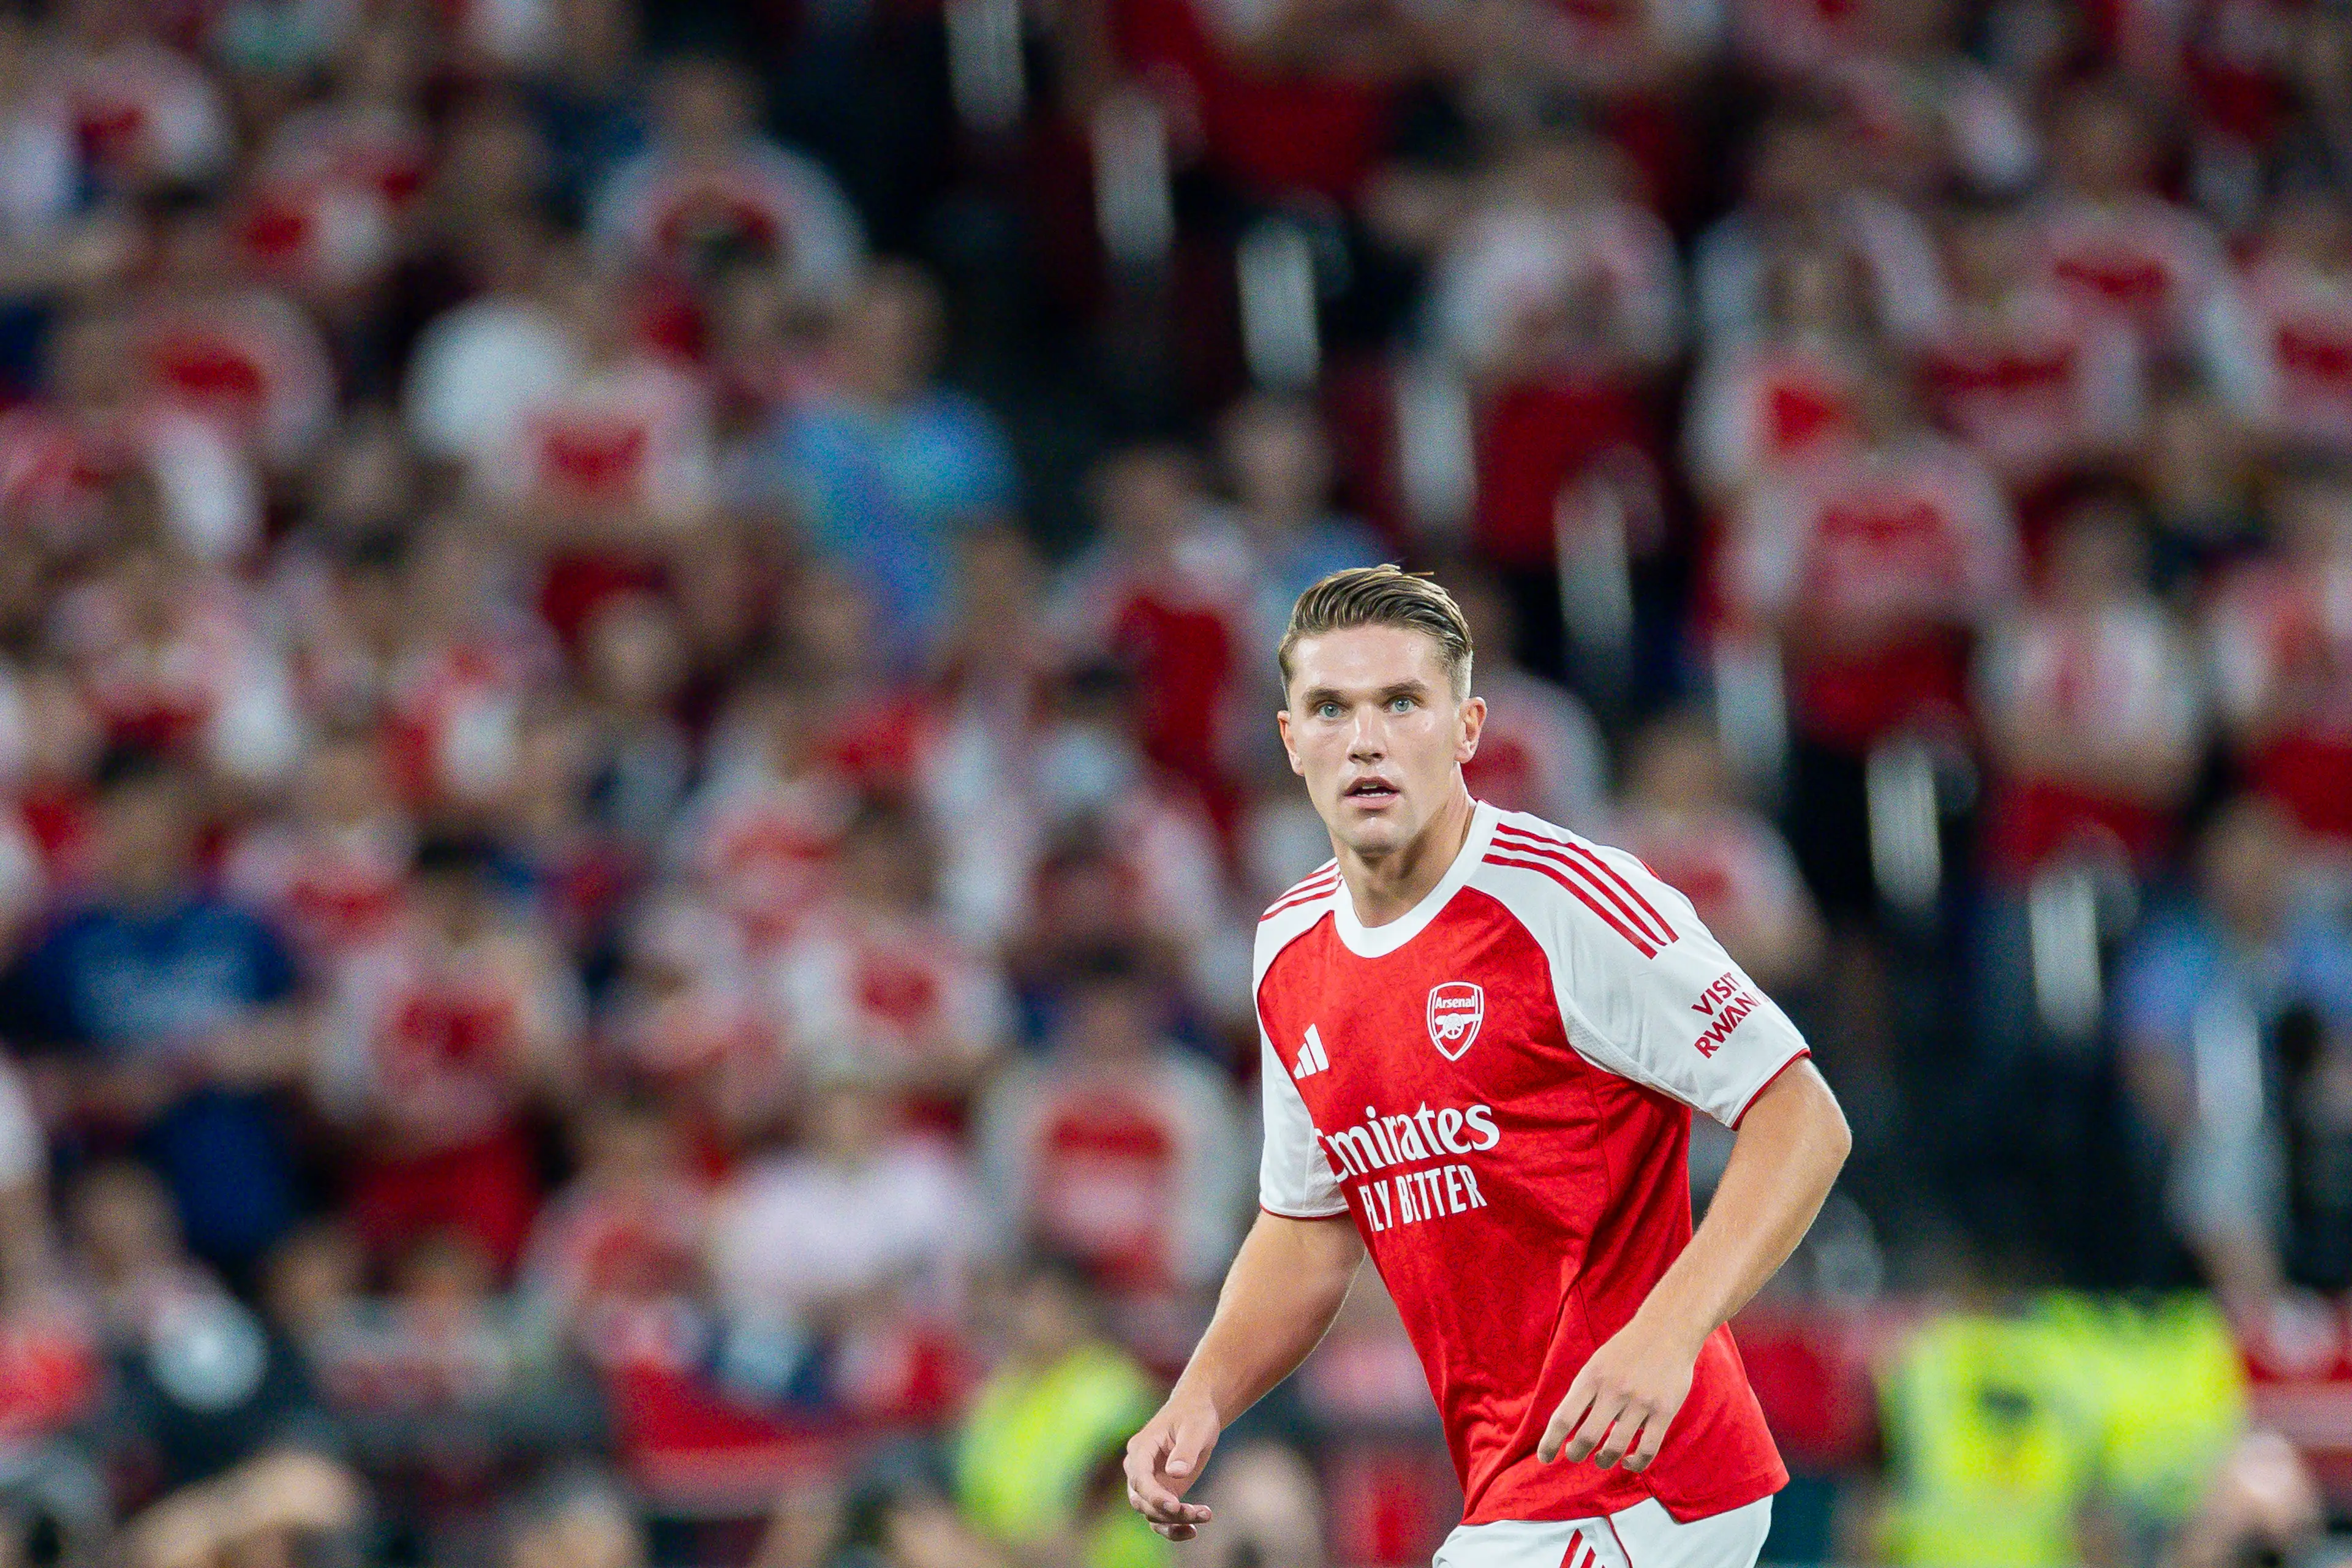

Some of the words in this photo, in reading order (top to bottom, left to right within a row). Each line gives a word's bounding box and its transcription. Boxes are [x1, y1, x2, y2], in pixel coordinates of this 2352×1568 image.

[1435, 995, 1475, 1009] Arsenal
[1691, 972, 1741, 1016] VISIT
[1358, 1180, 1393, 1232] FLY
[1395, 1164, 1487, 1224] BETTER
